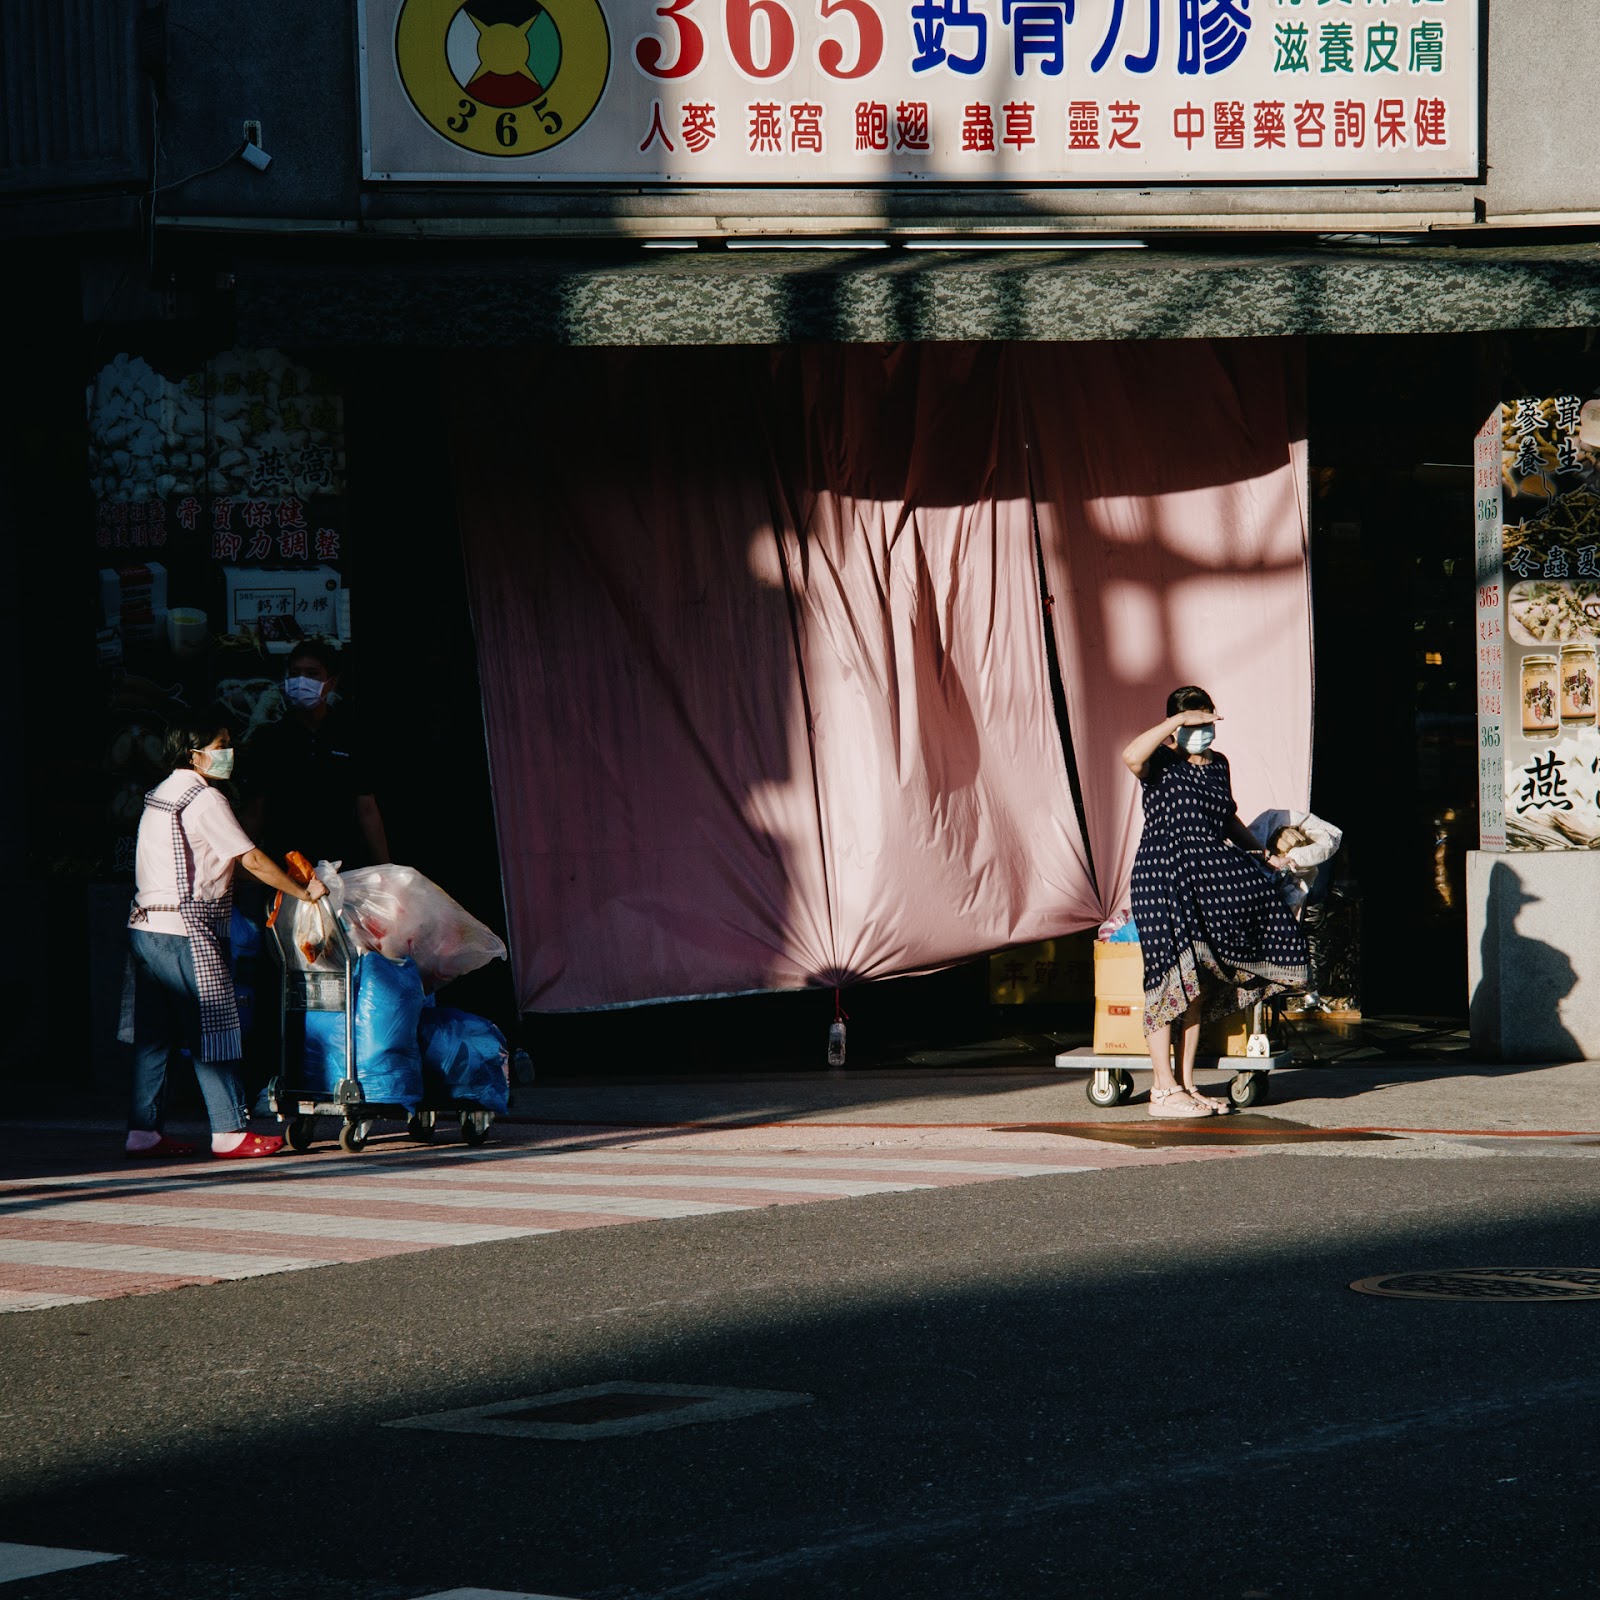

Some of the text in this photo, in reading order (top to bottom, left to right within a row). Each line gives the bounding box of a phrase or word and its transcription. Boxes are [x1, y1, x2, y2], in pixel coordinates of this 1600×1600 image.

[636, 0, 884, 79] 365
[1273, 20, 1445, 73] 滋養皮膚
[447, 98, 563, 147] 365
[640, 97, 1447, 153] 人蔘 燕窩 鮑翅 蟲草 靈芝 中醫藥咨詢保健
[252, 443, 332, 488] 燕窩
[1514, 436, 1583, 475] 養生
[1478, 498, 1498, 521] 365
[212, 528, 340, 562] 腳力調整
[1509, 545, 1600, 578] 冬蟲夏
[257, 597, 329, 614] 鈣骨力膠
[1479, 586, 1499, 608] 365
[1481, 726, 1501, 747] 365
[1516, 750, 1600, 815] 燕
